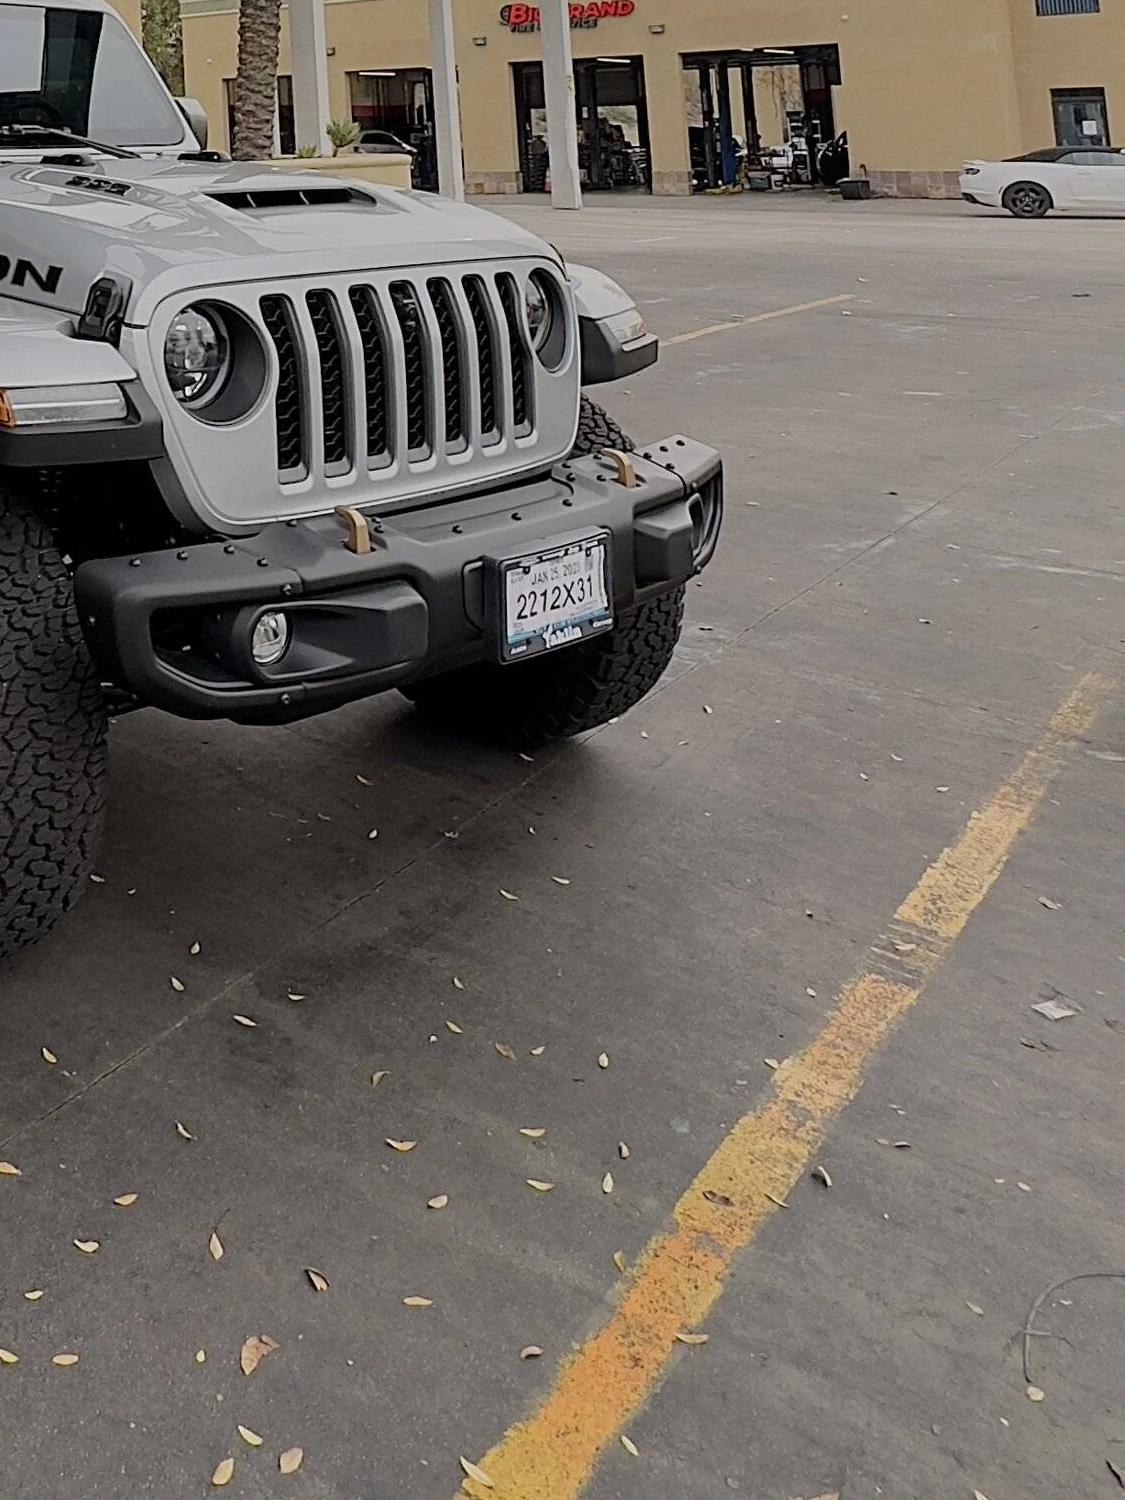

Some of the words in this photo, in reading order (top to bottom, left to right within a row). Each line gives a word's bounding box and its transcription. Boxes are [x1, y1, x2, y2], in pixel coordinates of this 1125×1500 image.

[508, 2, 541, 26] BI
[569, 0, 635, 18] RAND
[569, 17, 599, 30] VICE
[516, 574, 594, 621] 2212X31
